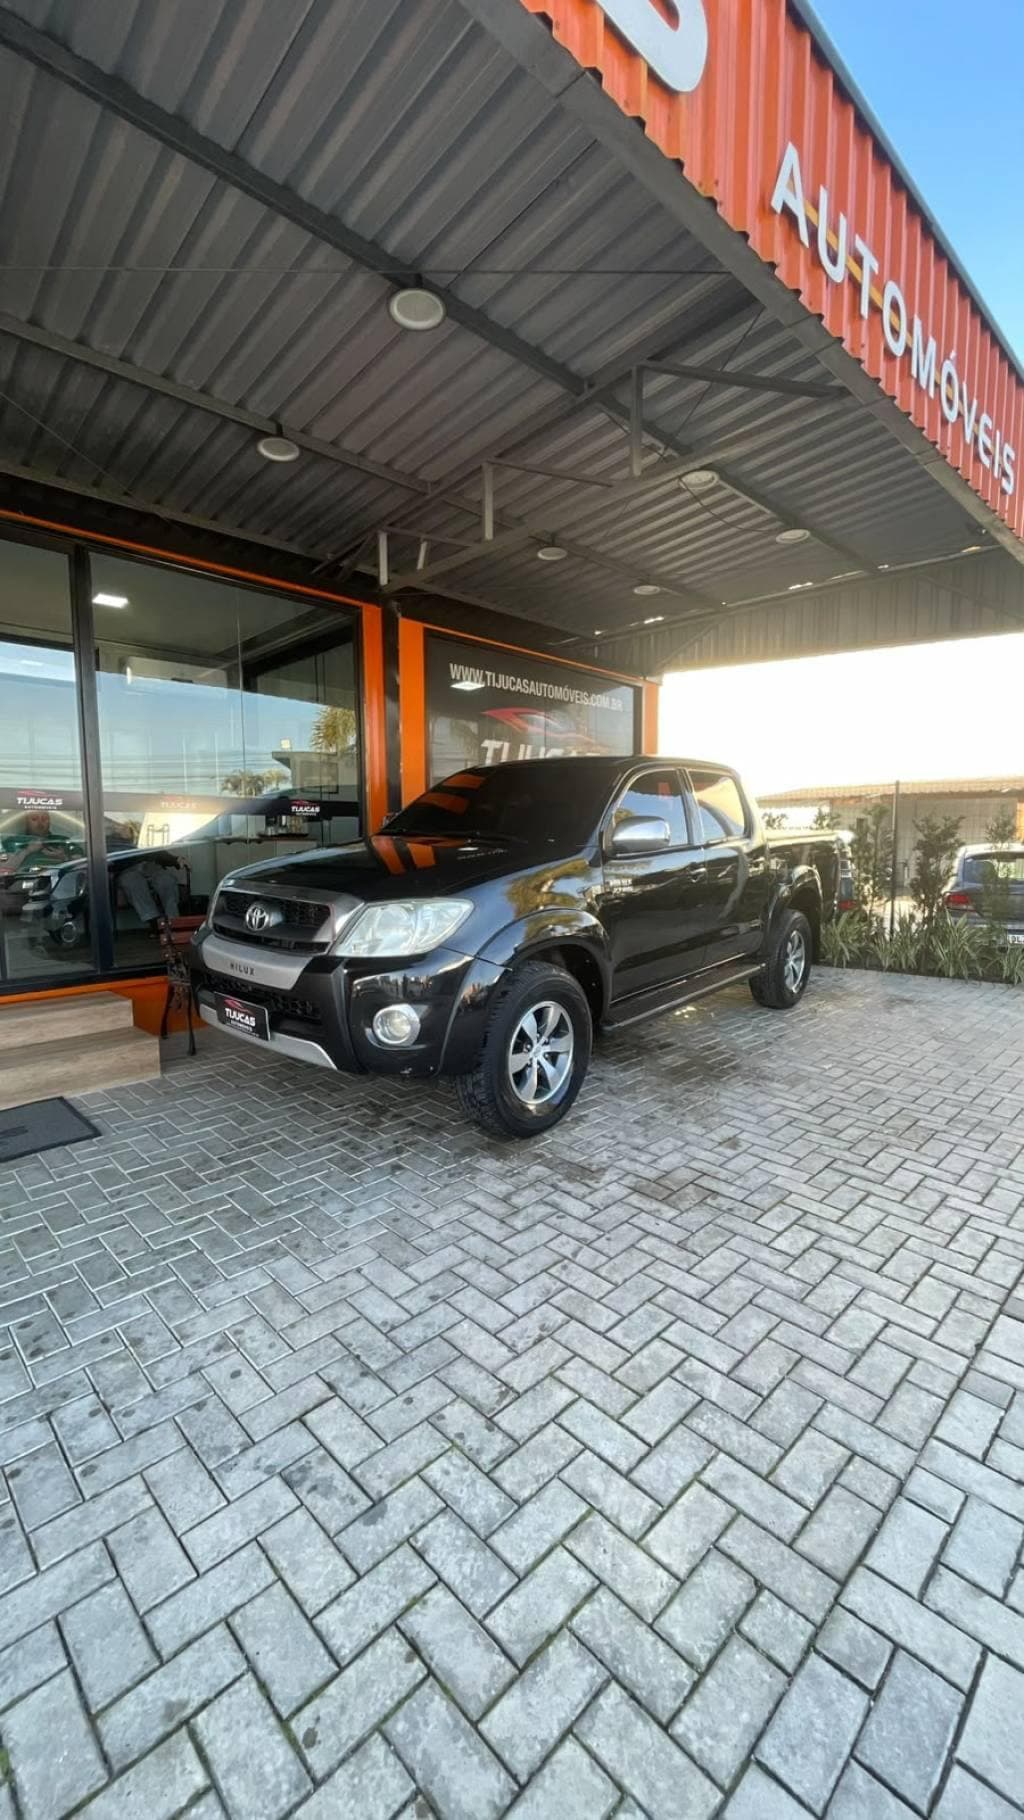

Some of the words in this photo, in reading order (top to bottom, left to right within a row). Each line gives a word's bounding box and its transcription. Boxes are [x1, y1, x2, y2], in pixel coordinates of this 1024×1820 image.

[770, 141, 1016, 495] AUTOMÓVEIS
[449, 662, 624, 712] WWW.TIJUCASAUTOMÓVEIS.COM.BR
[16, 796, 64, 806] TIJUCAS
[225, 1007, 256, 1027] TIJUCAS
